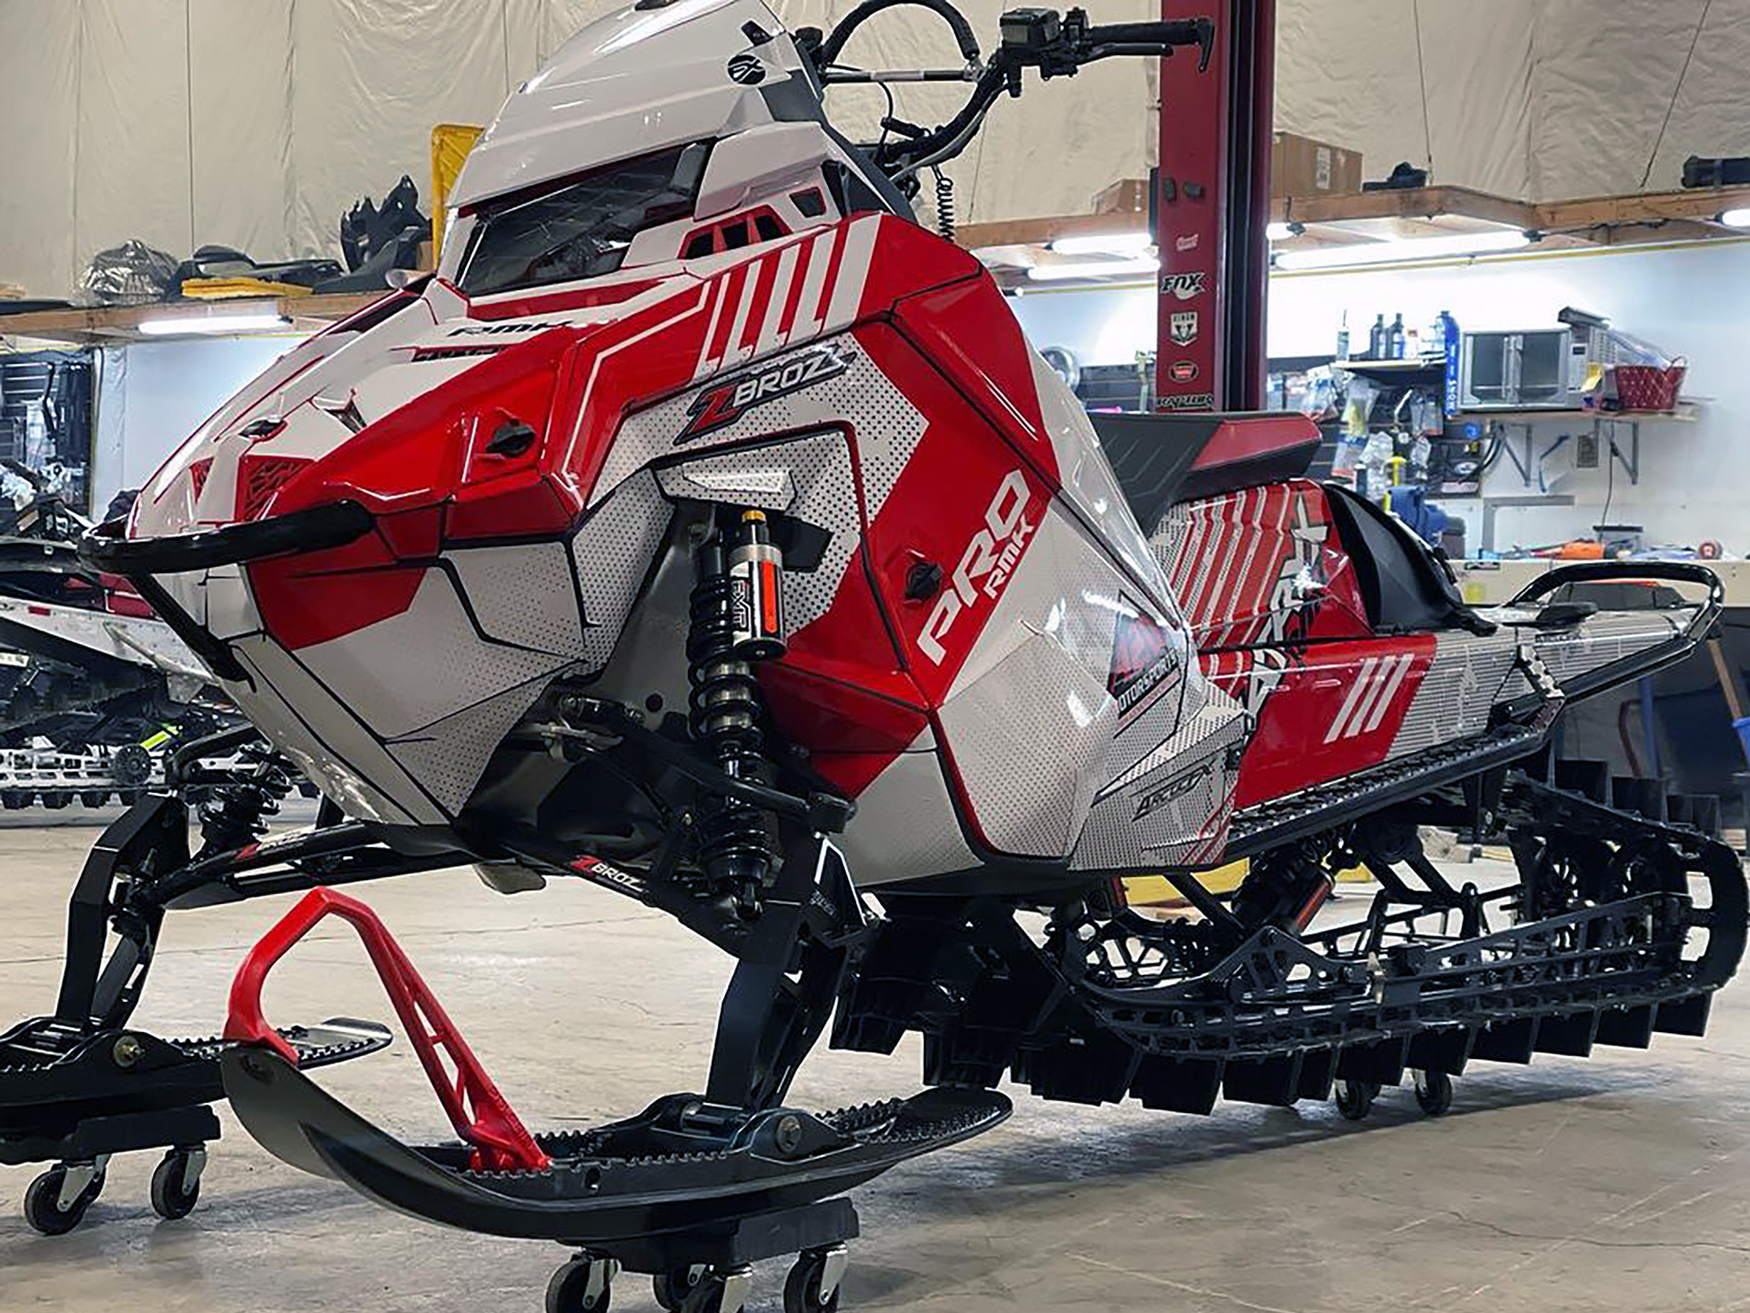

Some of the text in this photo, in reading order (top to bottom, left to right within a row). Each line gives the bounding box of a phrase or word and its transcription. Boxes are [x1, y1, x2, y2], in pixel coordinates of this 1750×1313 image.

[686, 345, 852, 436] ZBROZ
[917, 469, 1031, 667] PRO
[983, 514, 1034, 599] RMK
[570, 854, 648, 893] ZBROZ
